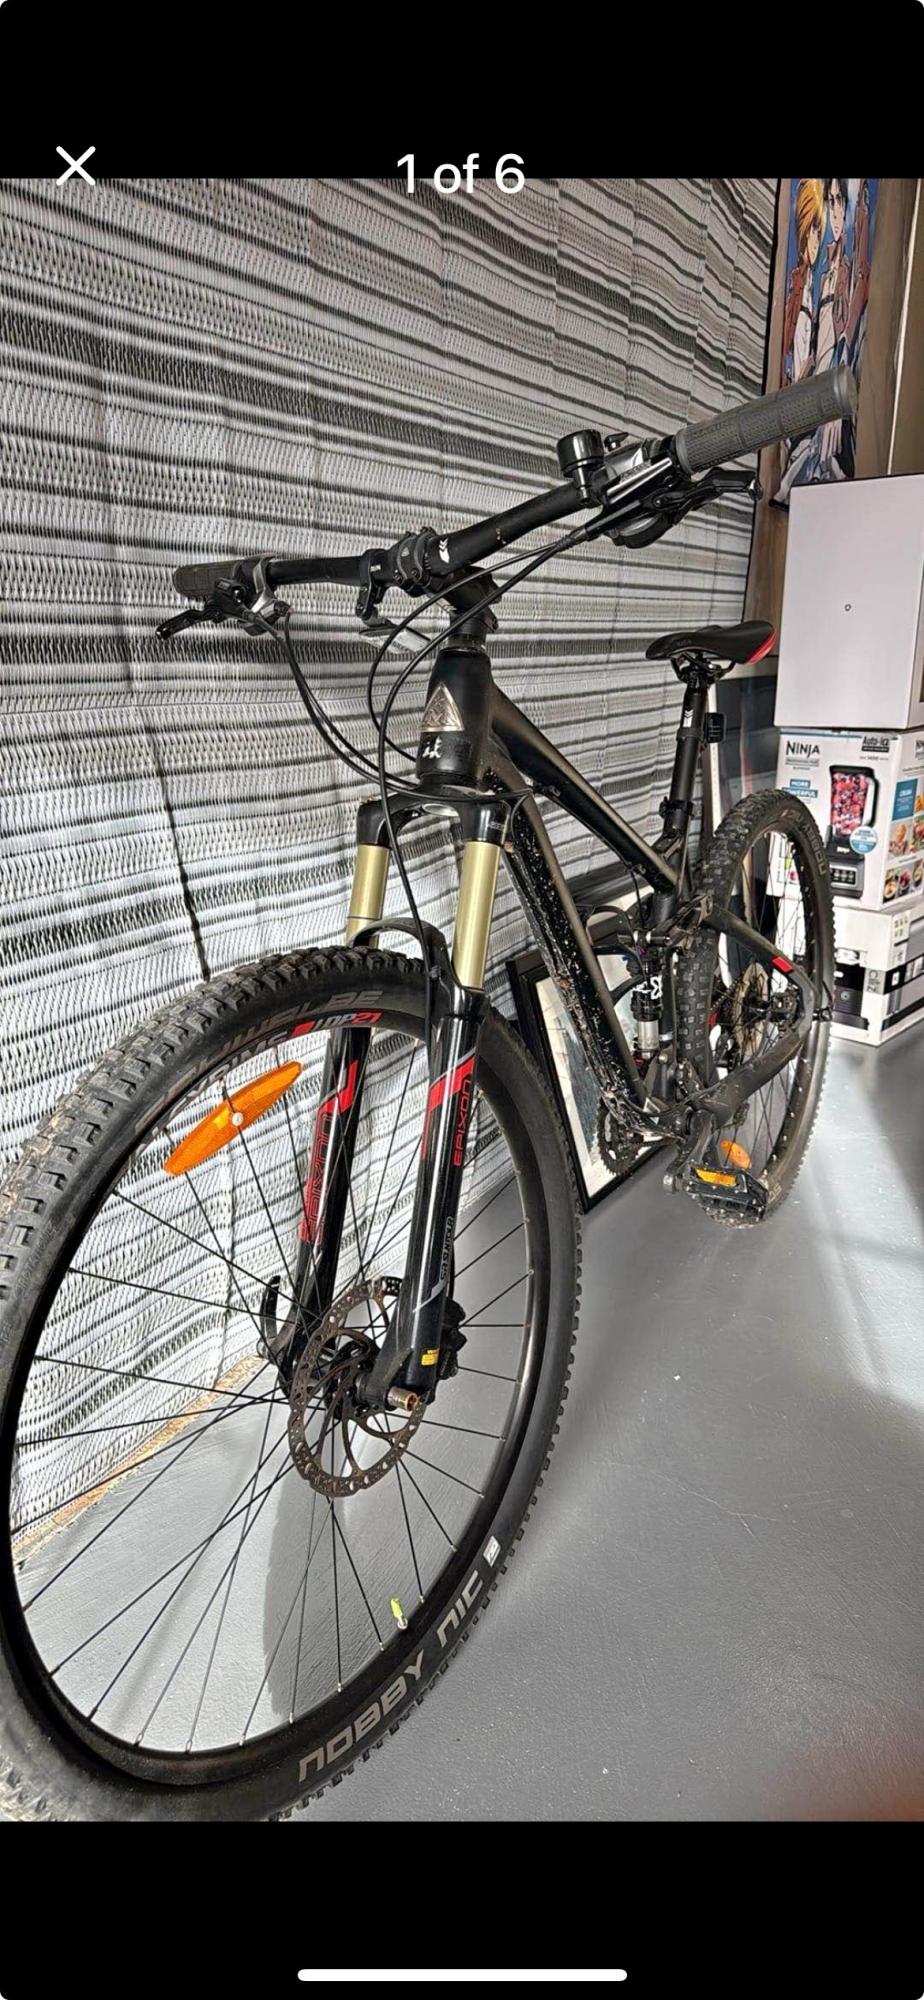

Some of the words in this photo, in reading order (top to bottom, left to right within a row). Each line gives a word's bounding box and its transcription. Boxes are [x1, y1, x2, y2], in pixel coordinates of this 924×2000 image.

[453, 1079, 472, 1168] EPIXON
[298, 1650, 424, 1782] NOBBY
[436, 1569, 483, 1648] NIC
